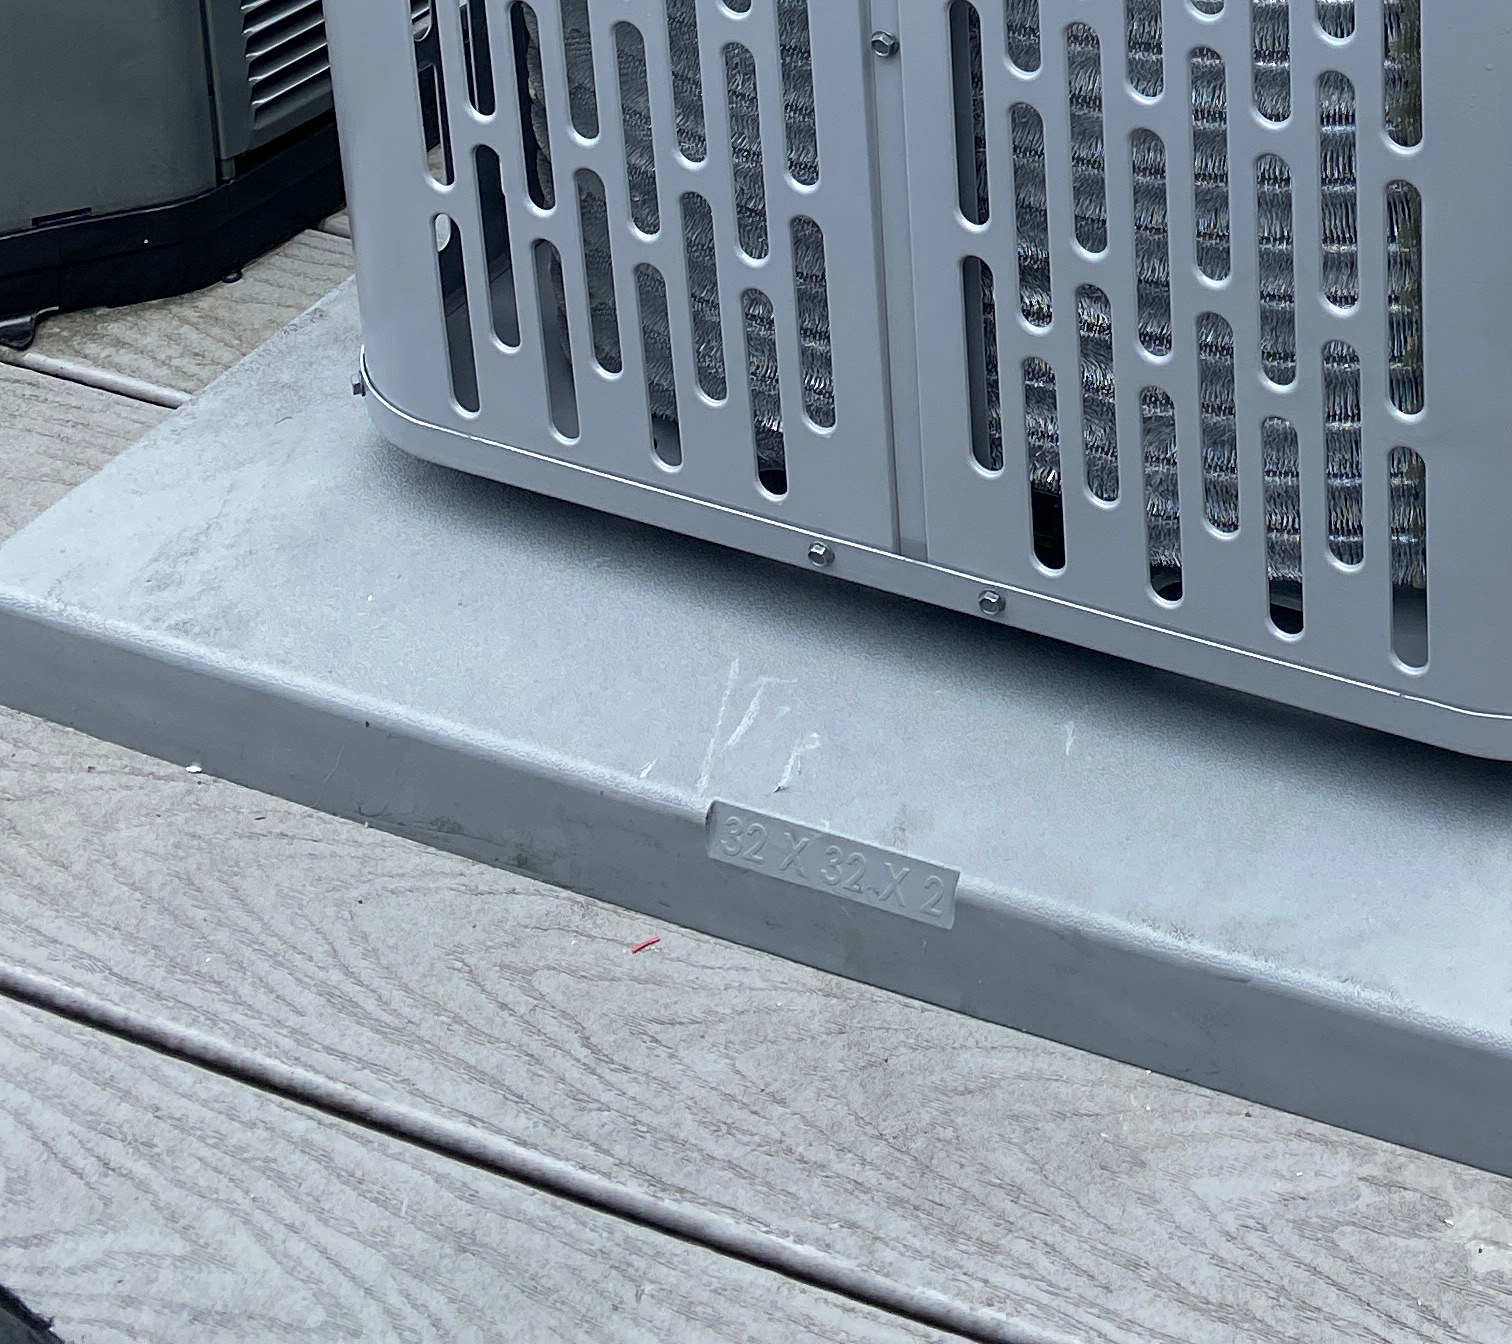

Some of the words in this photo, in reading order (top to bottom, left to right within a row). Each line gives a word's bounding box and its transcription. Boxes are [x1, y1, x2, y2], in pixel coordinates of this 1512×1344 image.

[720, 815, 768, 865] 32
[778, 832, 810, 879] X
[820, 844, 867, 895] 32
[879, 861, 911, 908] X
[919, 874, 946, 918] 2
